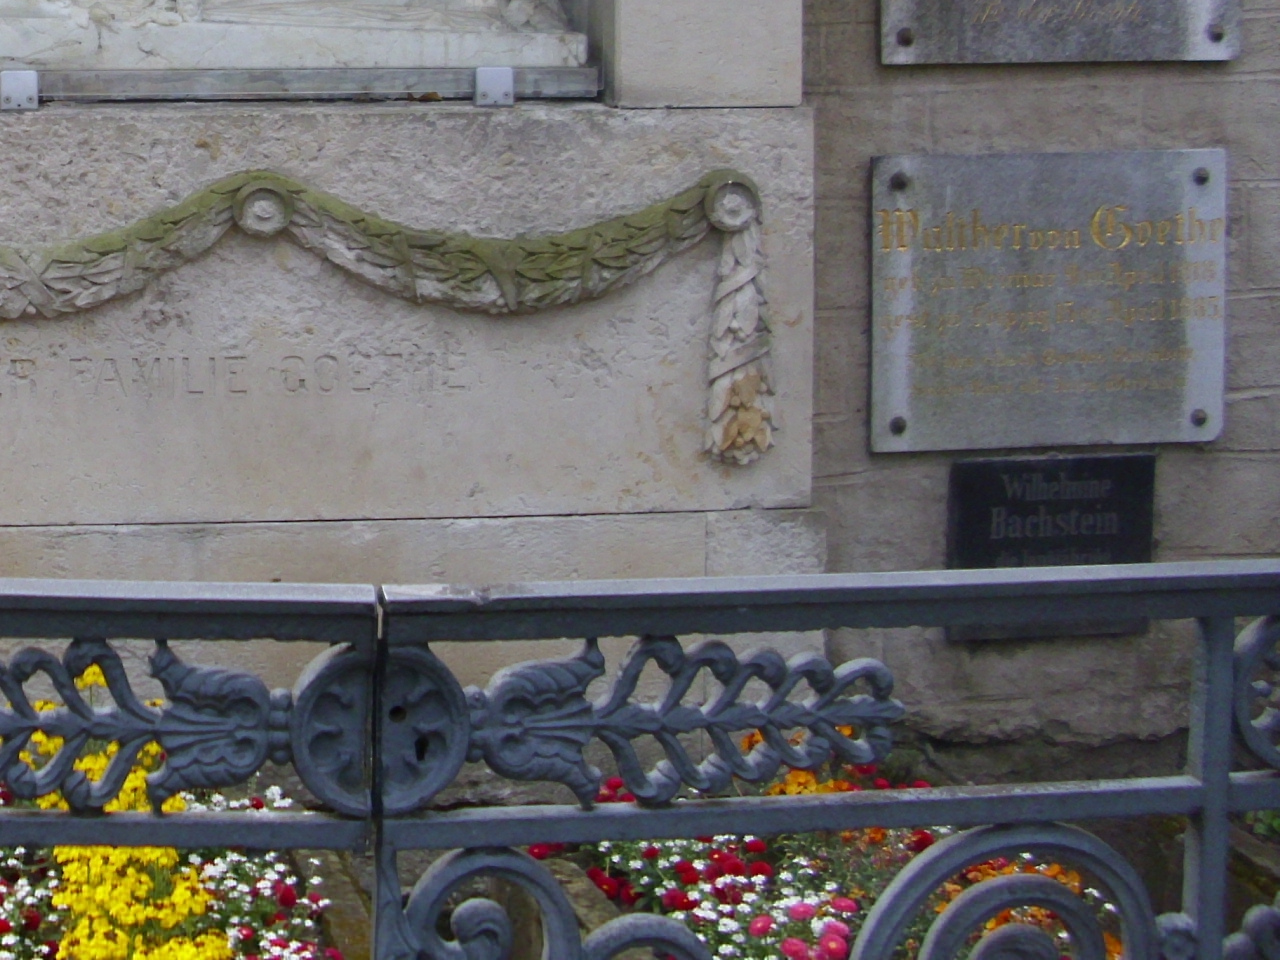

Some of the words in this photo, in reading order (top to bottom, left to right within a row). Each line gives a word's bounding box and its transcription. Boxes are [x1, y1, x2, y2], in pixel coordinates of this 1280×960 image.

[877, 207, 1028, 253] Walther
[1029, 227, 1083, 251] von
[1089, 204, 1227, 251] Goethe
[67, 355, 249, 398] FAMILIE
[999, 471, 1114, 502] Wilhelmine
[988, 503, 1122, 541] Bachstein
